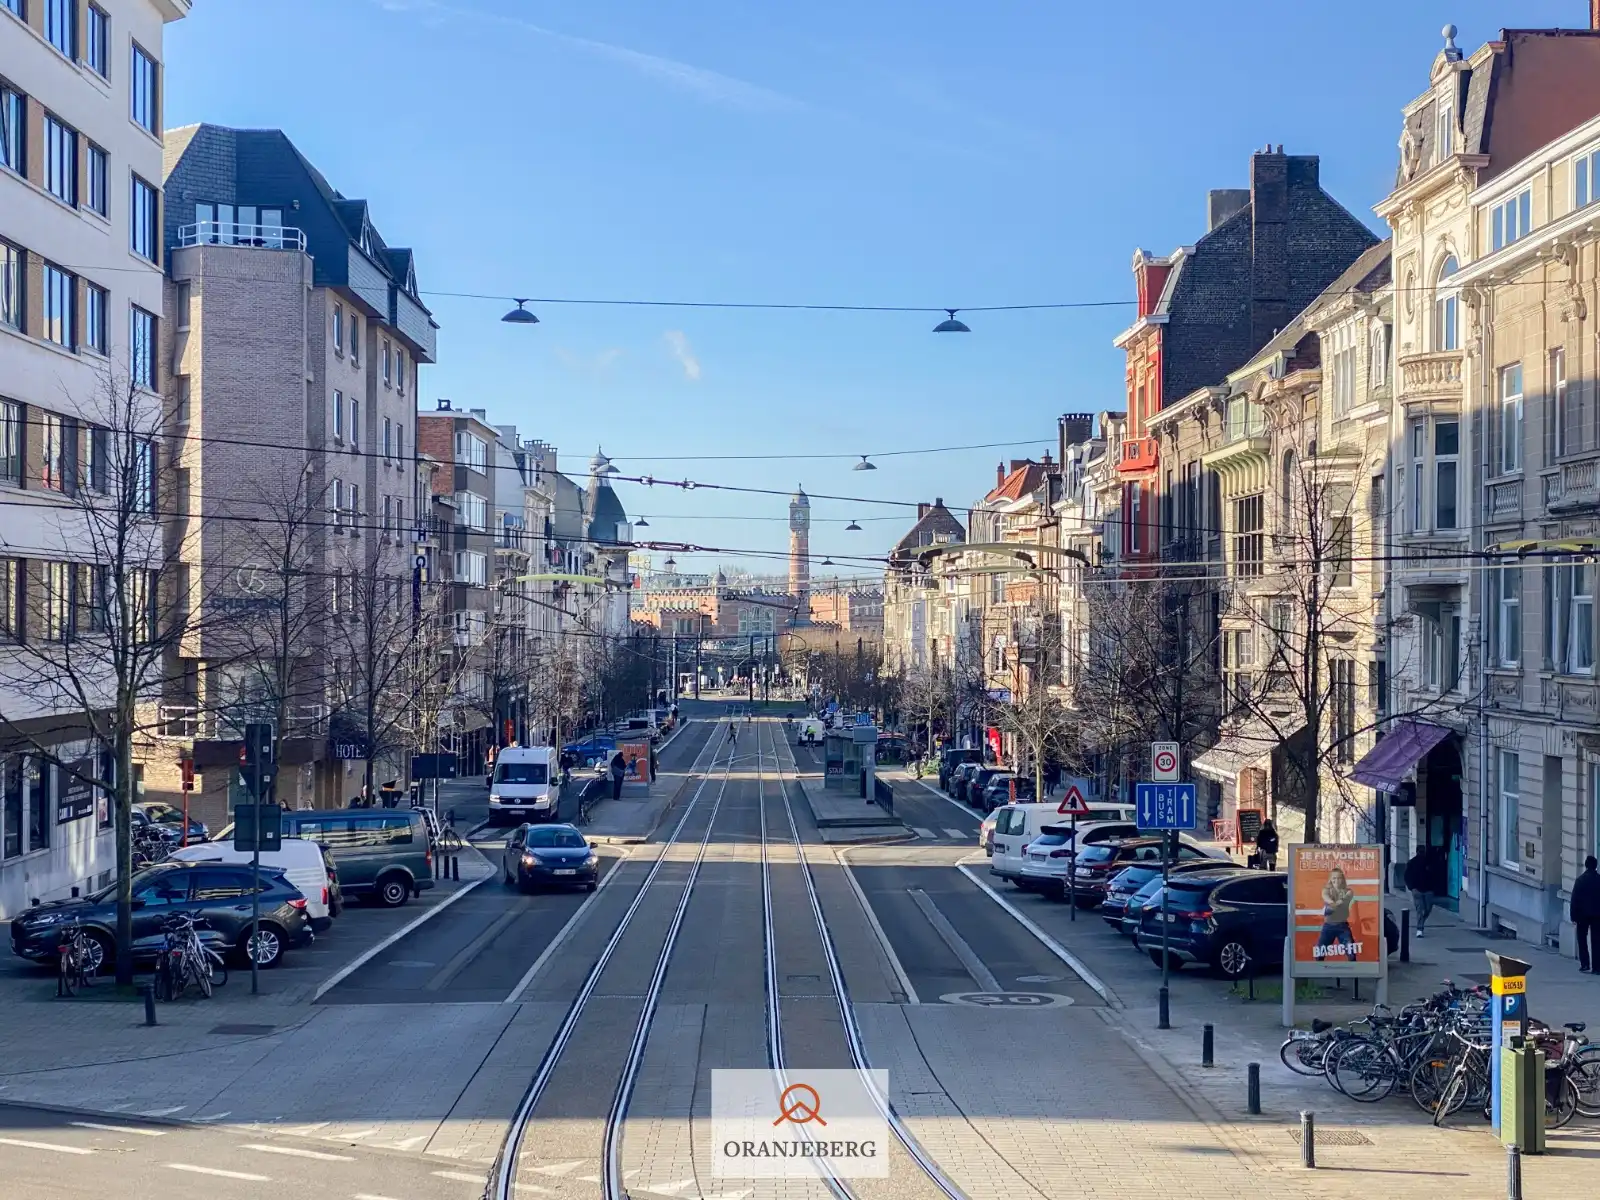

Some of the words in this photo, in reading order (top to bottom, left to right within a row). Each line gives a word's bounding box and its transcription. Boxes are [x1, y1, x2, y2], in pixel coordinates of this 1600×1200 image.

[336, 744, 366, 758] HOTE
[1160, 758, 1171, 766] 30
[1166, 789, 1174, 824] TRAM
[1300, 851, 1313, 860] JE
[1314, 851, 1330, 860] FIT
[1332, 851, 1375, 860] VOELEN
[1299, 860, 1352, 871] BEGINT
[1353, 860, 1375, 871] NU
[971, 996, 1041, 1004] 30
[1505, 996, 1516, 1012] P
